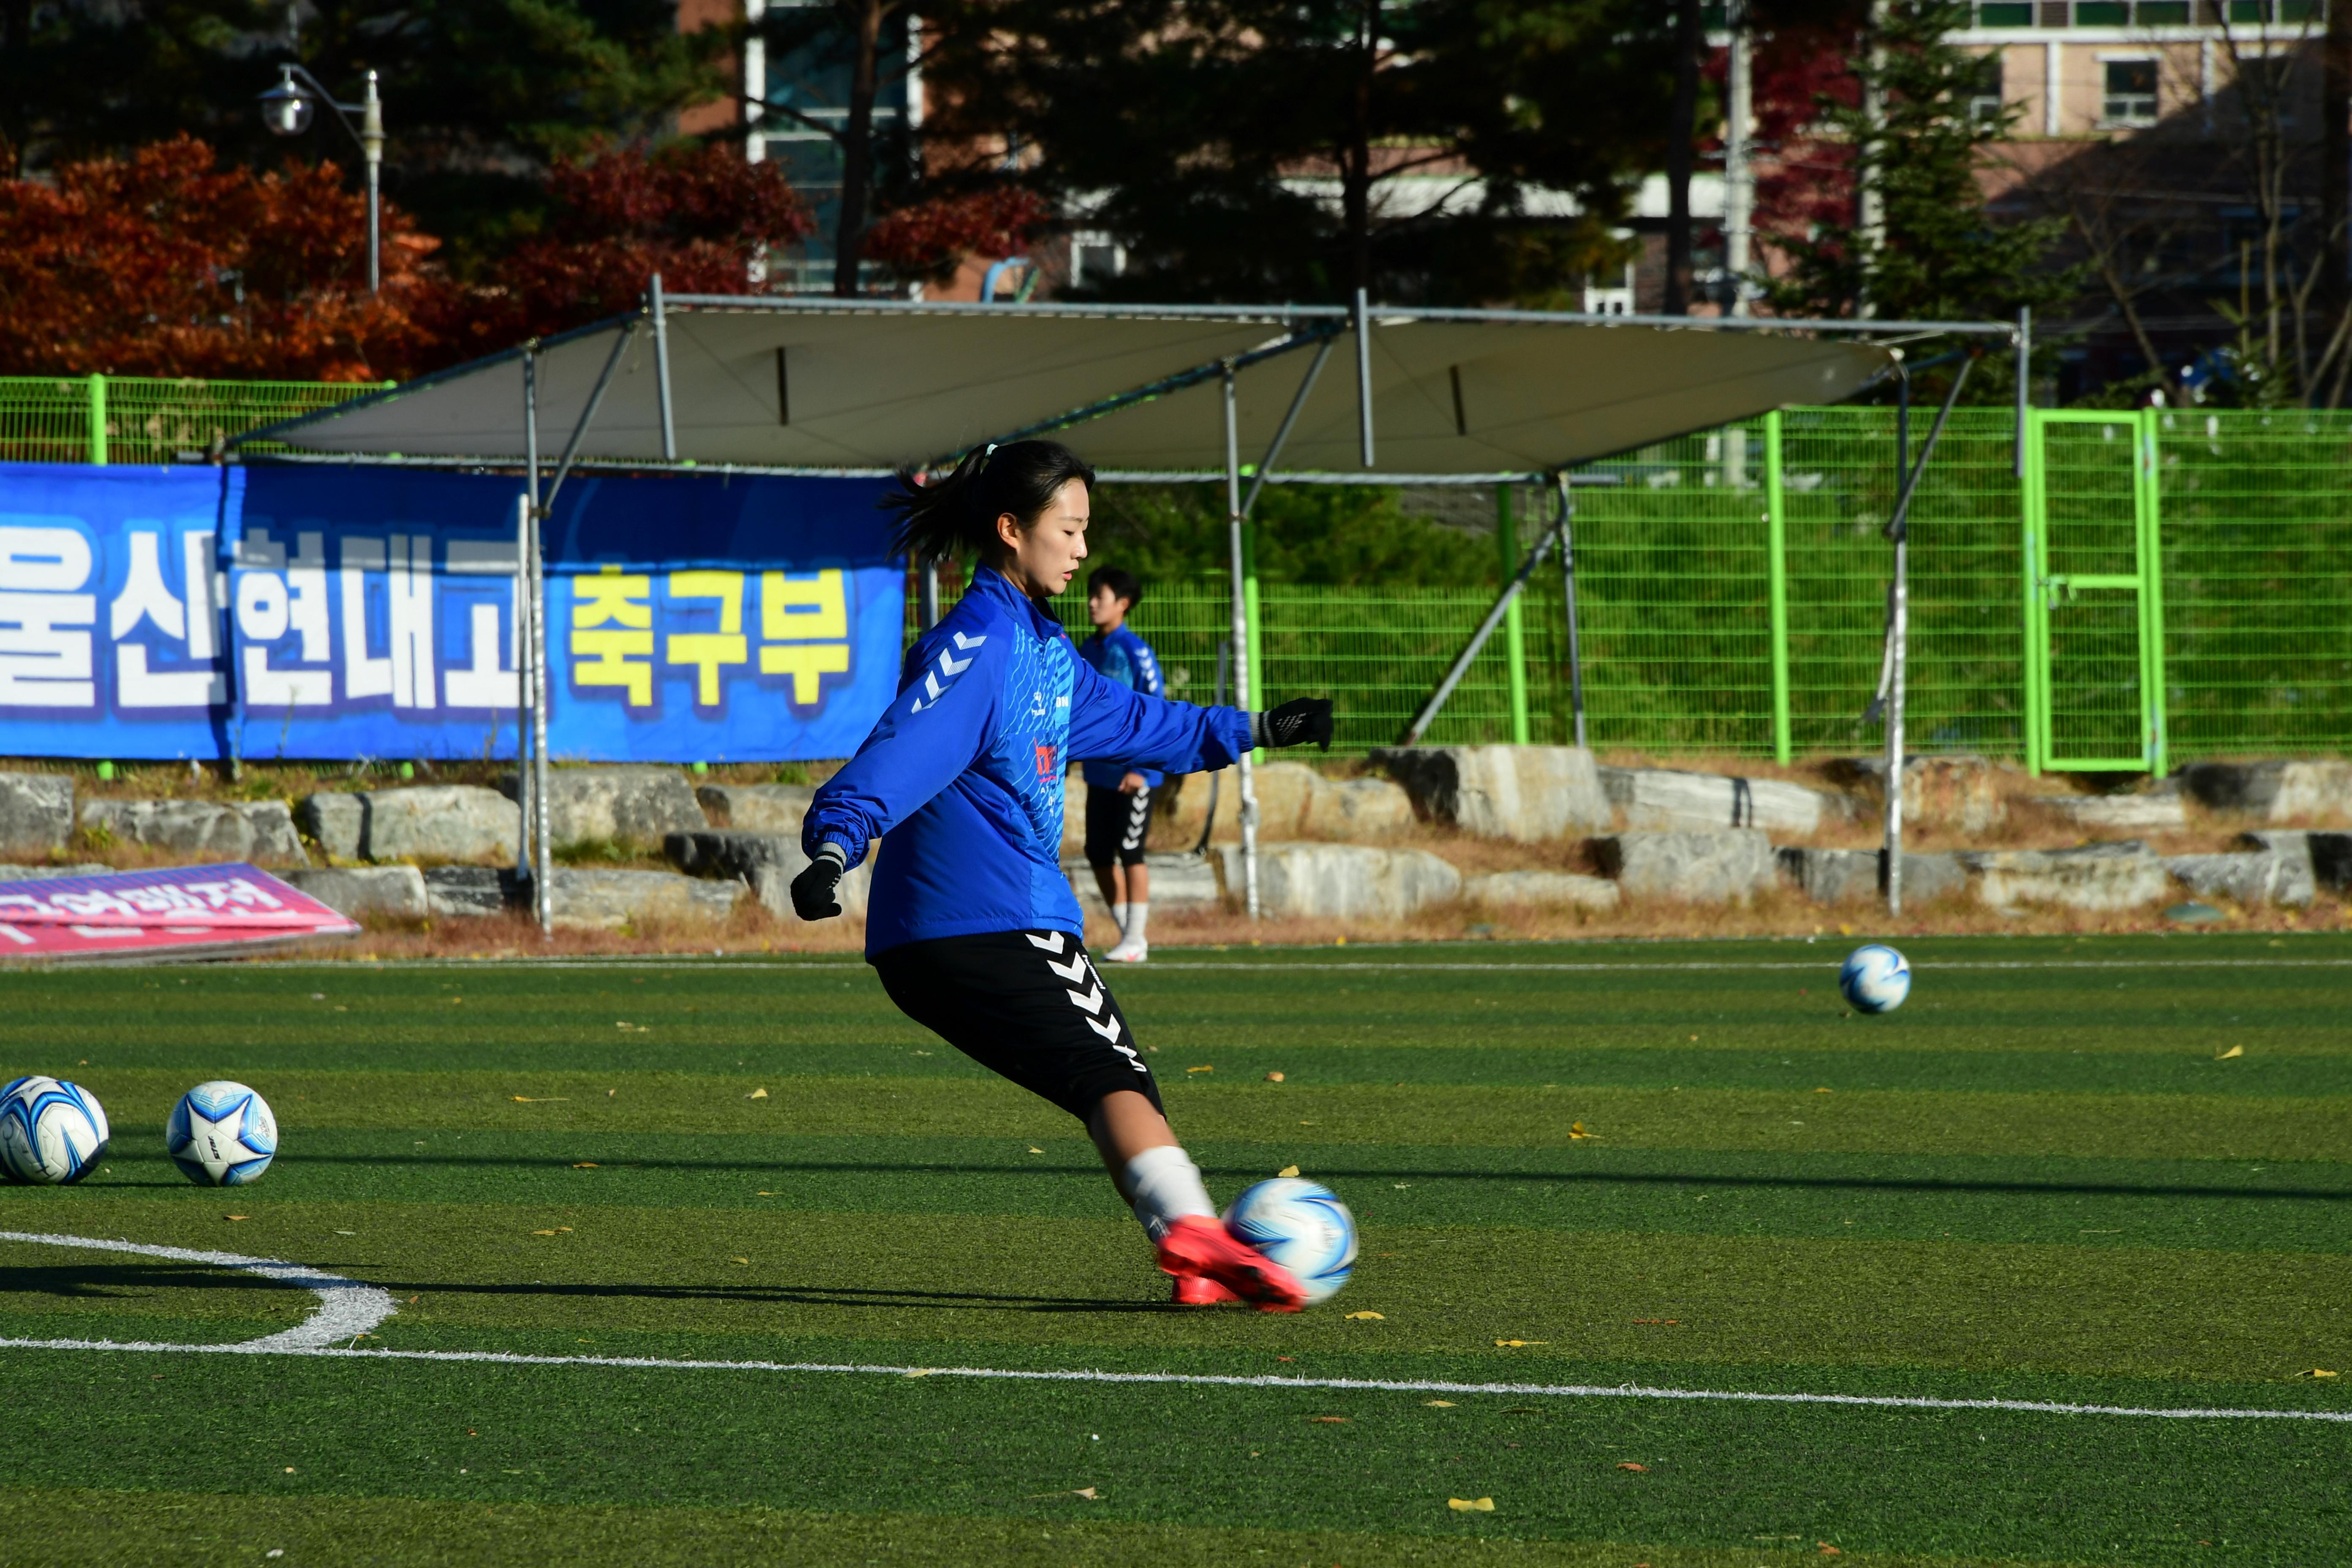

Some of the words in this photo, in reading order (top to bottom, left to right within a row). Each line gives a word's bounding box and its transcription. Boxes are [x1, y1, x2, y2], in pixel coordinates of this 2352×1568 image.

[0, 528, 534, 708] 울산현대고
[571, 564, 849, 706] 축구부
[1082, 955, 1106, 990] hummel
